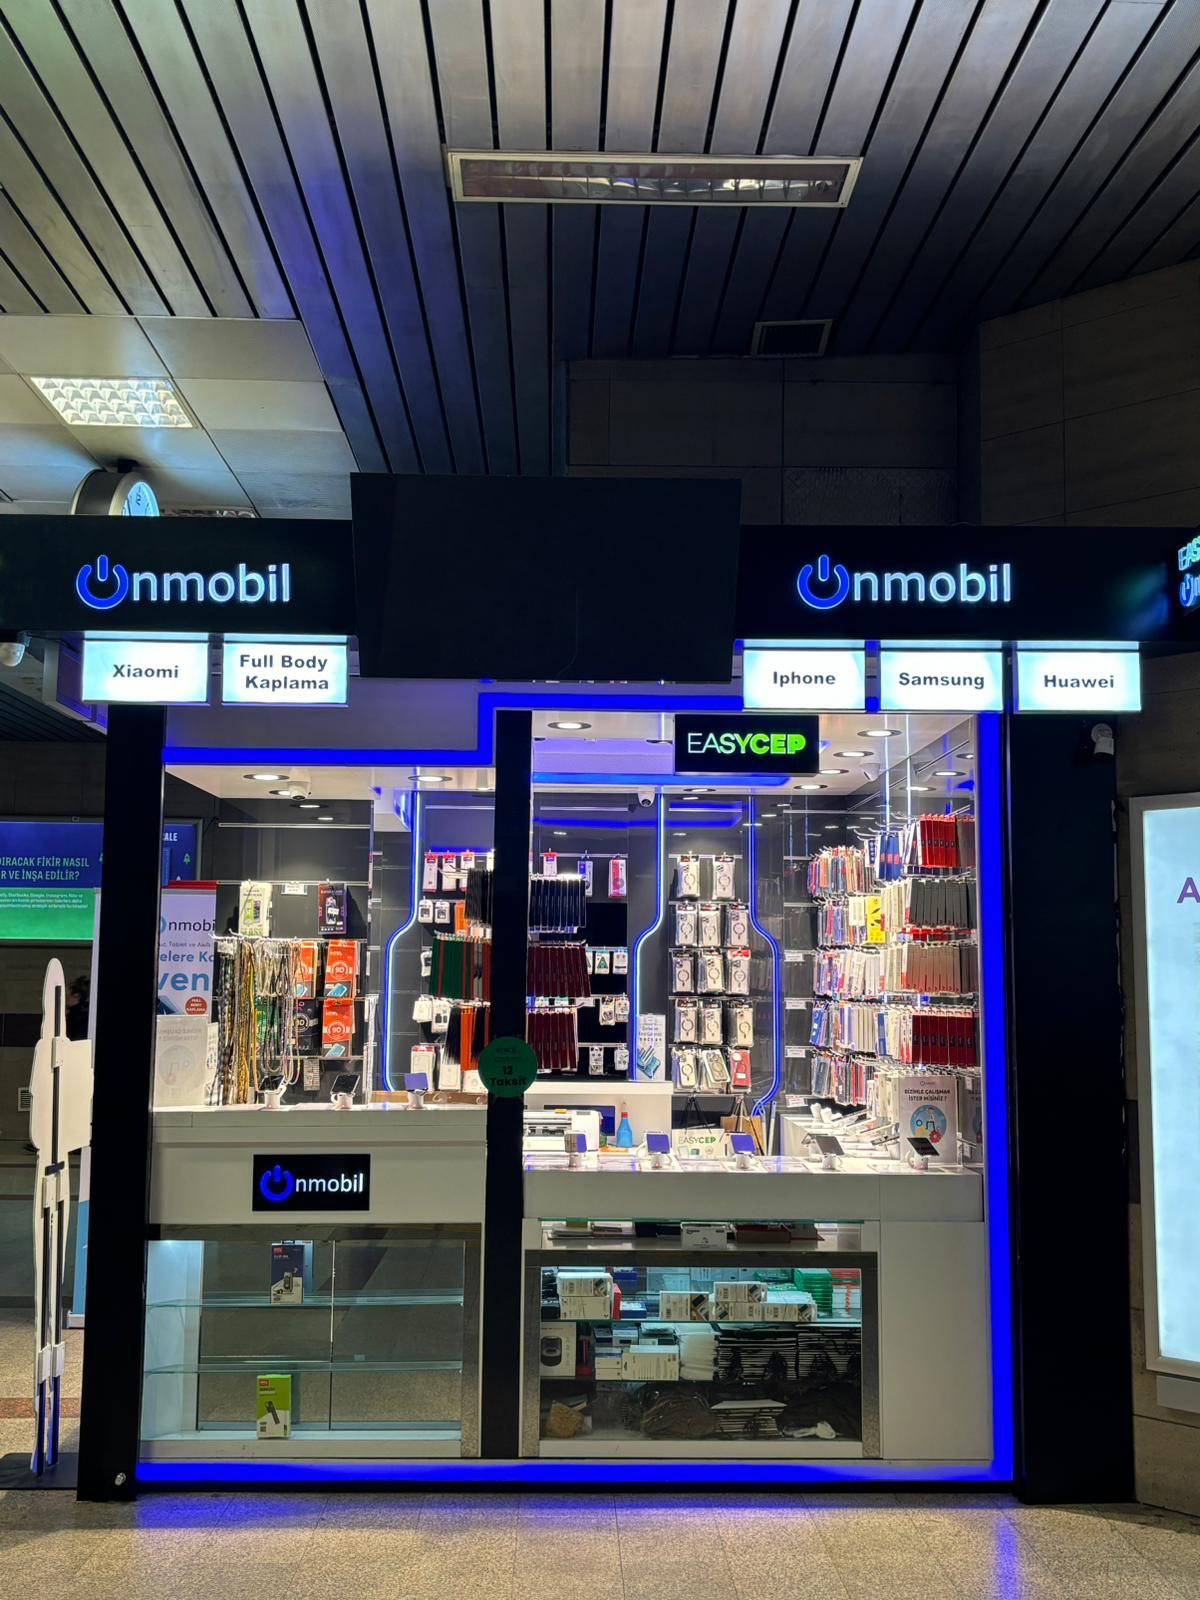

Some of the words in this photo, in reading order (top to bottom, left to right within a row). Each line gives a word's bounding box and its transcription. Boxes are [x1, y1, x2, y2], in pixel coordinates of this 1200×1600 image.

[239, 654, 274, 669] Full
[281, 656, 328, 672] Body
[112, 664, 179, 679] Xiaomi
[772, 671, 836, 687] Iphone
[245, 675, 330, 690] Kaplama
[898, 671, 985, 689] Samsung
[1043, 674, 1115, 689] Huawei
[687, 732, 806, 754] EASYCEP
[36, 855, 61, 867] FİKİR
[63, 857, 90, 868] NASIL
[8, 870, 20, 880] VE
[21, 868, 43, 882] İNŞA
[45, 869, 80, 881] EDİLİR?
[488, 1075, 527, 1087] Taksit
